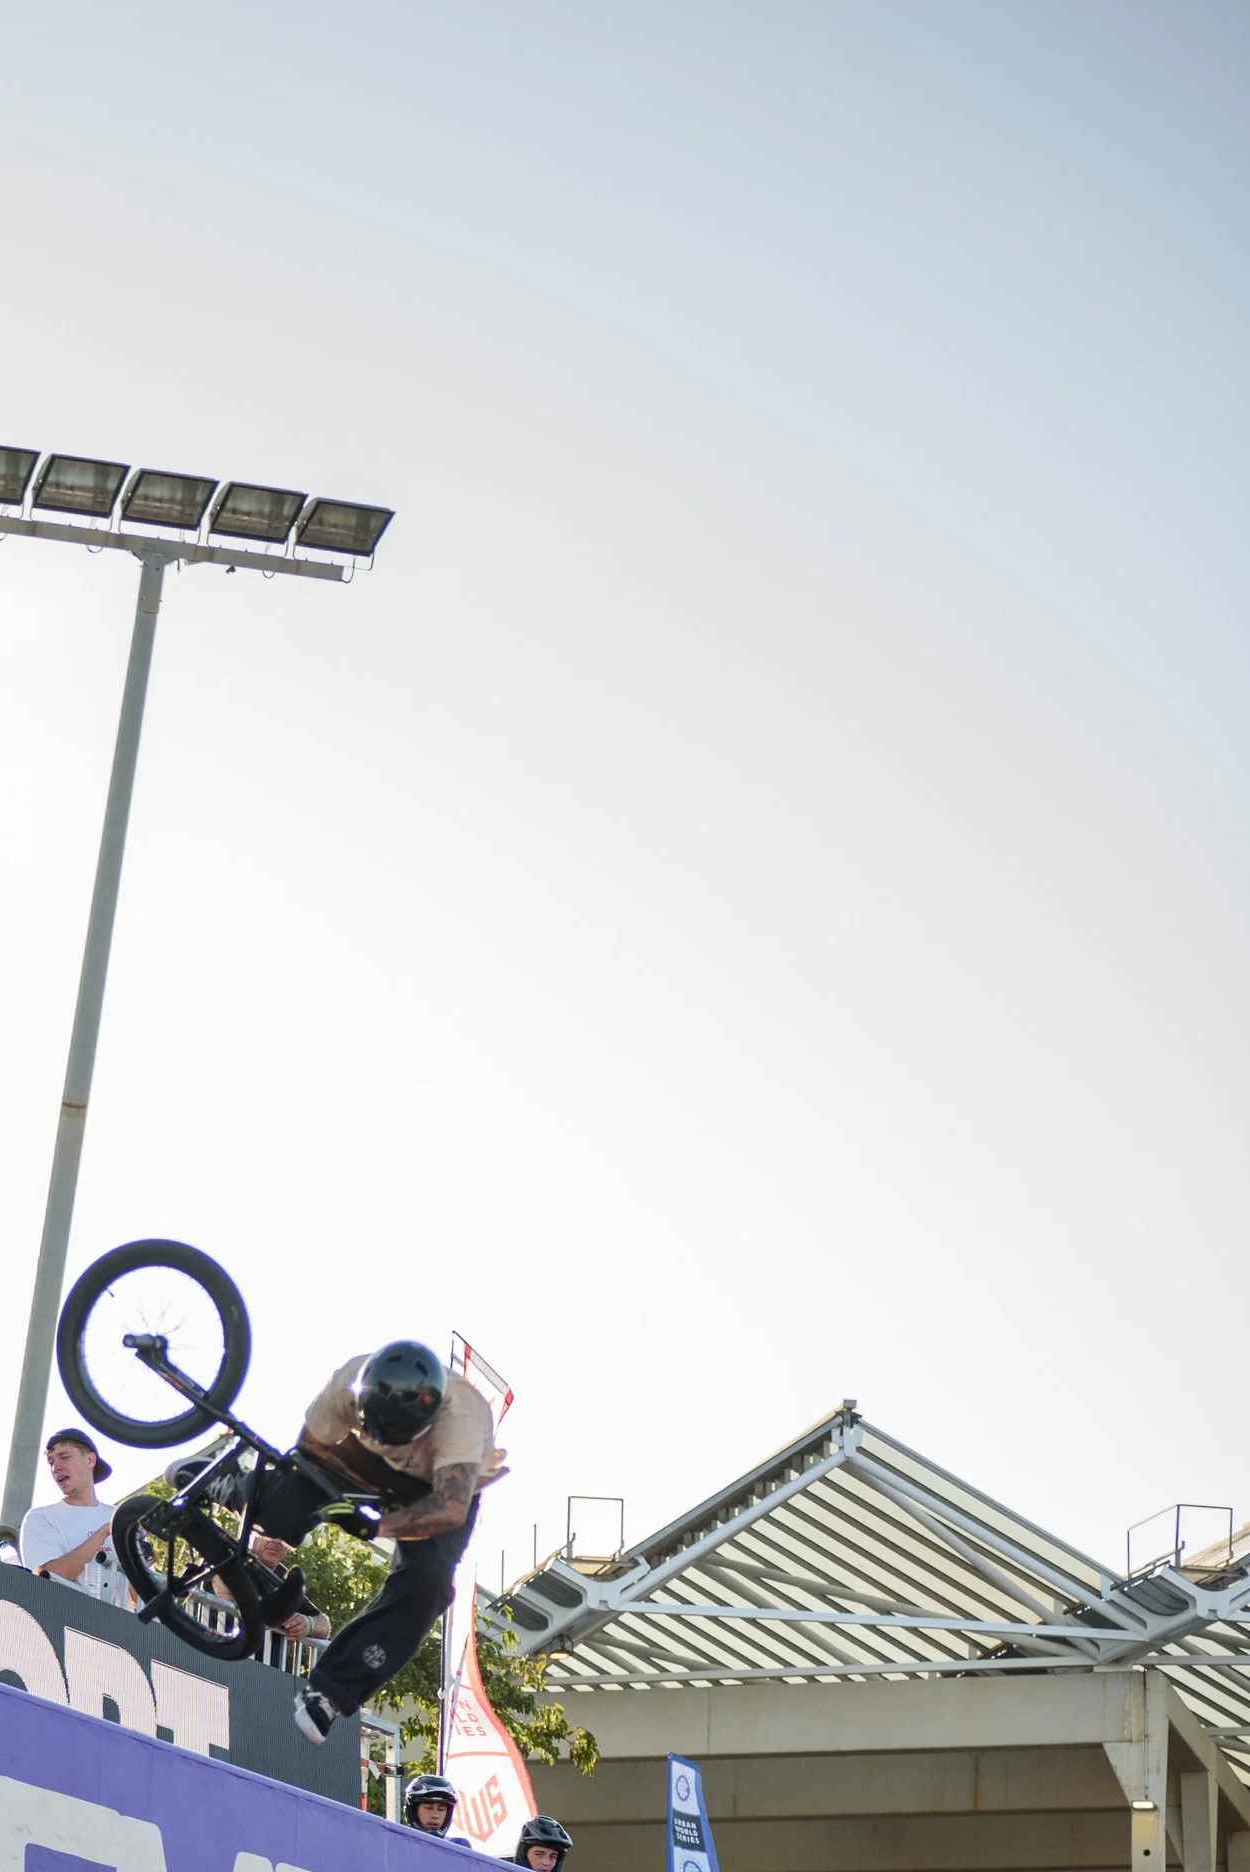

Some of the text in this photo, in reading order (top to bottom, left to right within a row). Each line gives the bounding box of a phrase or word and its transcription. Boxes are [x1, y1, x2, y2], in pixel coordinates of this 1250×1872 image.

[673, 1817, 697, 1829] URBAN
[674, 1825, 699, 1837] WORLD
[676, 1833, 700, 1844] SERIES
